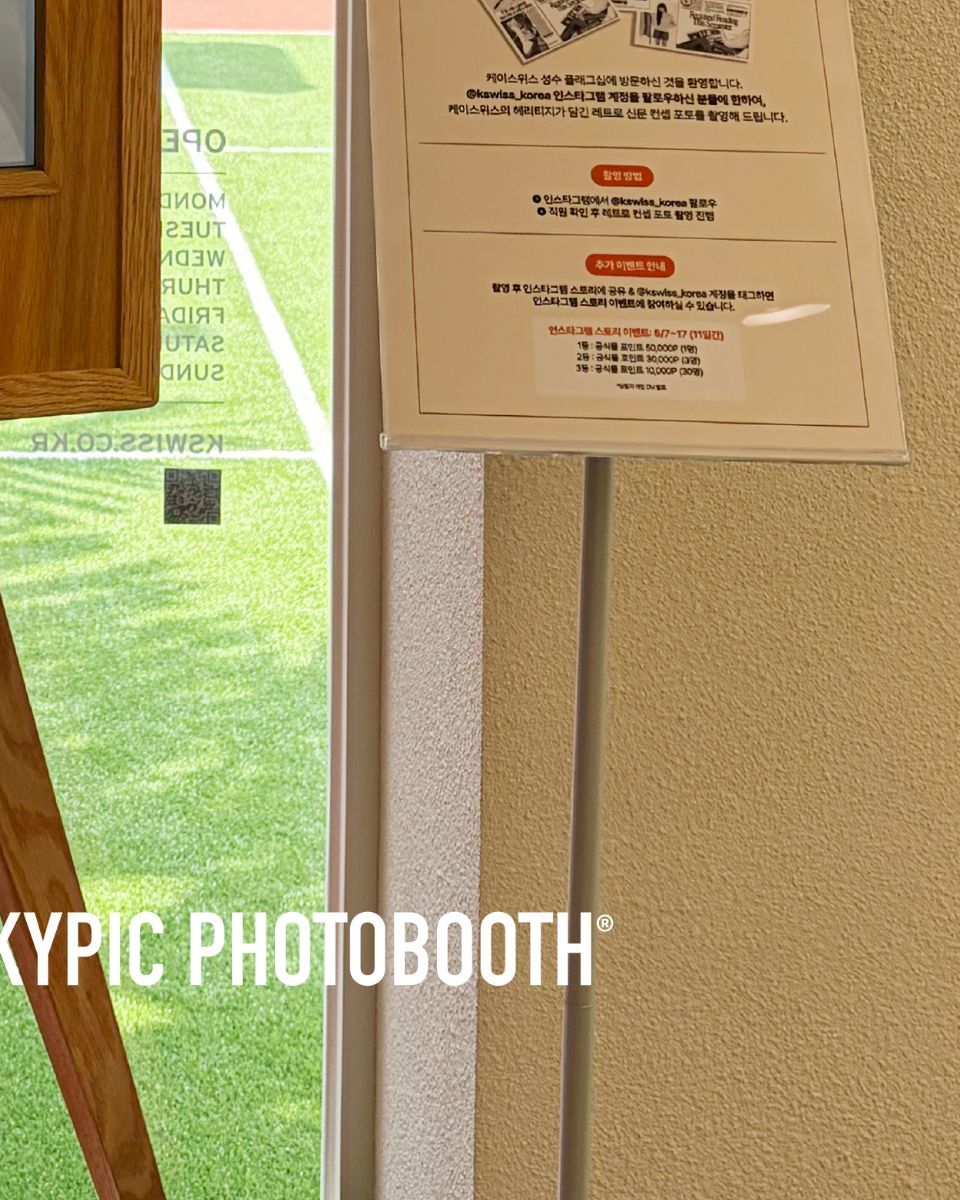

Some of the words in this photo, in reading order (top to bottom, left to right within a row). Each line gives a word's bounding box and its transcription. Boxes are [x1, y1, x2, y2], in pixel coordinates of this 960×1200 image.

[486, 72, 539, 85] 케이스위스
[540, 73, 562, 86] 성수
[564, 74, 618, 87] 플래그십에
[618, 75, 661, 88] 방문하신
[663, 76, 685, 89] 것을
[686, 77, 743, 90] 환영합니다.
[466, 88, 552, 101] @kswiss_korea
[552, 89, 606, 103] 인스타그램
[607, 91, 640, 103] 계정을
[641, 91, 695, 105] 팔로우하신
[730, 94, 766, 108] 한하여,
[448, 103, 511, 116] 케이스위스의
[512, 105, 566, 118] 헤리티지가
[567, 106, 590, 119] 담긴
[591, 106, 624, 118] 레트로
[626, 107, 648, 120] 신문
[649, 108, 671, 120] 컨셉
[673, 109, 705, 121] 포토를
[707, 109, 740, 122] 촬영해
[742, 111, 788, 123] 드립니다.
[545, 194, 609, 206] 인스타그램에서
[610, 196, 688, 208] @kswiss_korea
[688, 198, 718, 209] 팔로우
[590, 207, 600, 218] 후
[632, 208, 652, 220] 컨셉
[695, 210, 714, 222] 진행
[511, 283, 522, 294] 후
[522, 283, 568, 295] 인스타그램
[569, 285, 606, 296] 스토리에
[607, 285, 626, 297] 공유
[532, 296, 578, 308] 인스타그램
[579, 297, 607, 308] 스토리
[608, 297, 646, 309] 이벤트에
[684, 300, 695, 311] 수
[695, 300, 735, 312] 있습니다.
